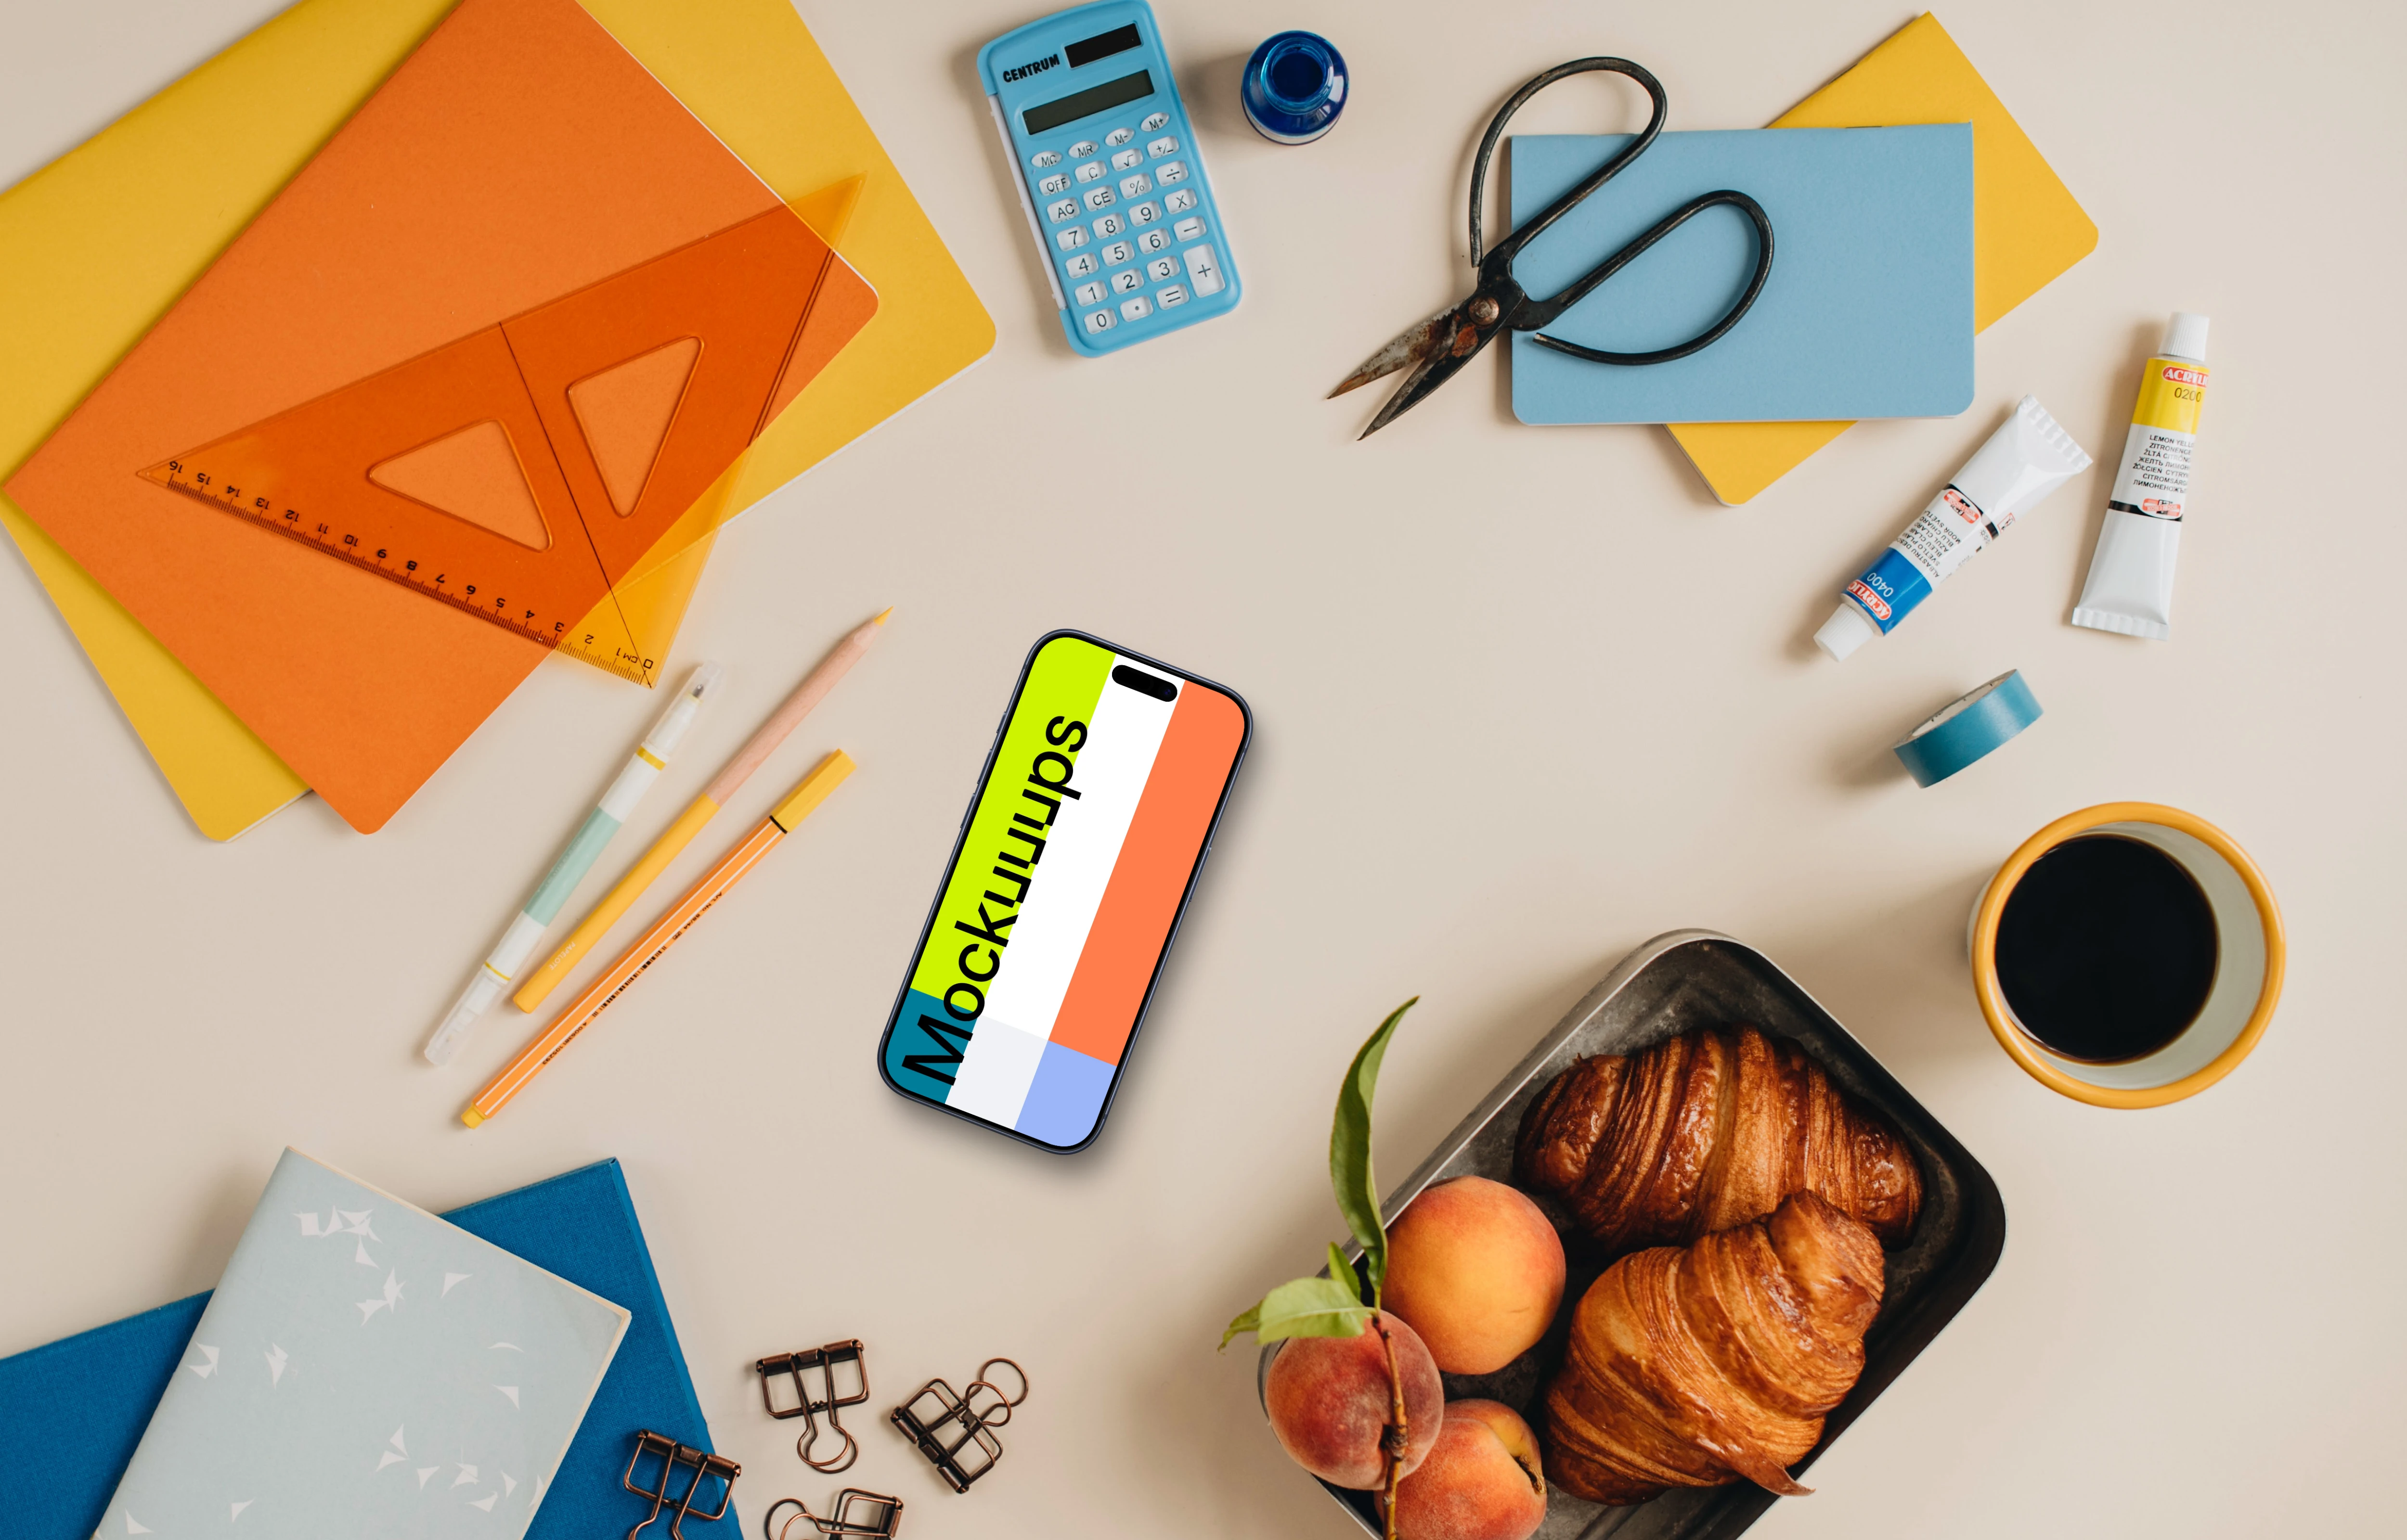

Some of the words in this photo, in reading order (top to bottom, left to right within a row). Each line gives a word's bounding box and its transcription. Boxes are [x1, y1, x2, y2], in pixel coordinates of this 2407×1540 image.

[1003, 53, 1060, 83] CENTRUM
[1078, 145, 1092, 158] MR
[1149, 118, 1164, 131] M+
[1046, 178, 1067, 192] OFF
[1088, 167, 1098, 180] C
[1058, 204, 1074, 218] AC
[1092, 191, 1111, 206] CE
[1068, 230, 1078, 245] 7
[1105, 219, 1116, 233] 8
[1140, 207, 1152, 221] 9
[1079, 258, 1089, 271] 4
[1113, 245, 1125, 260] 5
[1149, 234, 1161, 248] 6
[1088, 286, 1097, 301] 1
[1123, 274, 1136, 289] 2
[1158, 262, 1170, 276] 3
[1096, 314, 1107, 327] 0
[2174, 387, 2201, 402] 0200
[2149, 435, 2174, 444] LEMON
[169, 461, 182, 473] 16
[197, 473, 211, 485] 15
[227, 485, 240, 498] 14
[256, 497, 270, 510] 13
[285, 509, 300, 522] 12
[318, 523, 328, 534] 11
[1914, 522, 1933, 538] CLARO
[1919, 516, 1941, 535] CHIARO
[344, 534, 359, 547] 10
[1909, 528, 1926, 542] CLAIR
[1941, 535, 1954, 547] BLU
[1896, 538, 1912, 549] DESC
[1926, 541, 1942, 557] BLEU
[1934, 537, 1949, 552] AZUL
[377, 549, 387, 558] 9
[1917, 544, 1940, 566] SVETLO
[406, 561, 417, 571] 8
[1911, 549, 1940, 578] ALBASTRU
[435, 574, 445, 583] 7
[1867, 572, 1893, 597] 0400
[466, 585, 476, 595] 6
[496, 598, 506, 608] 5
[1848, 581, 1889, 617] ACRYLIC
[526, 610, 535, 618] 4
[555, 622, 565, 632] 3
[584, 634, 594, 644] 2
[616, 647, 621, 656] 1
[623, 653, 638, 663] CM
[643, 659, 653, 669] 0
[901, 715, 1088, 1087] Mockuuups
[549, 941, 576, 970] PAPELOTE
